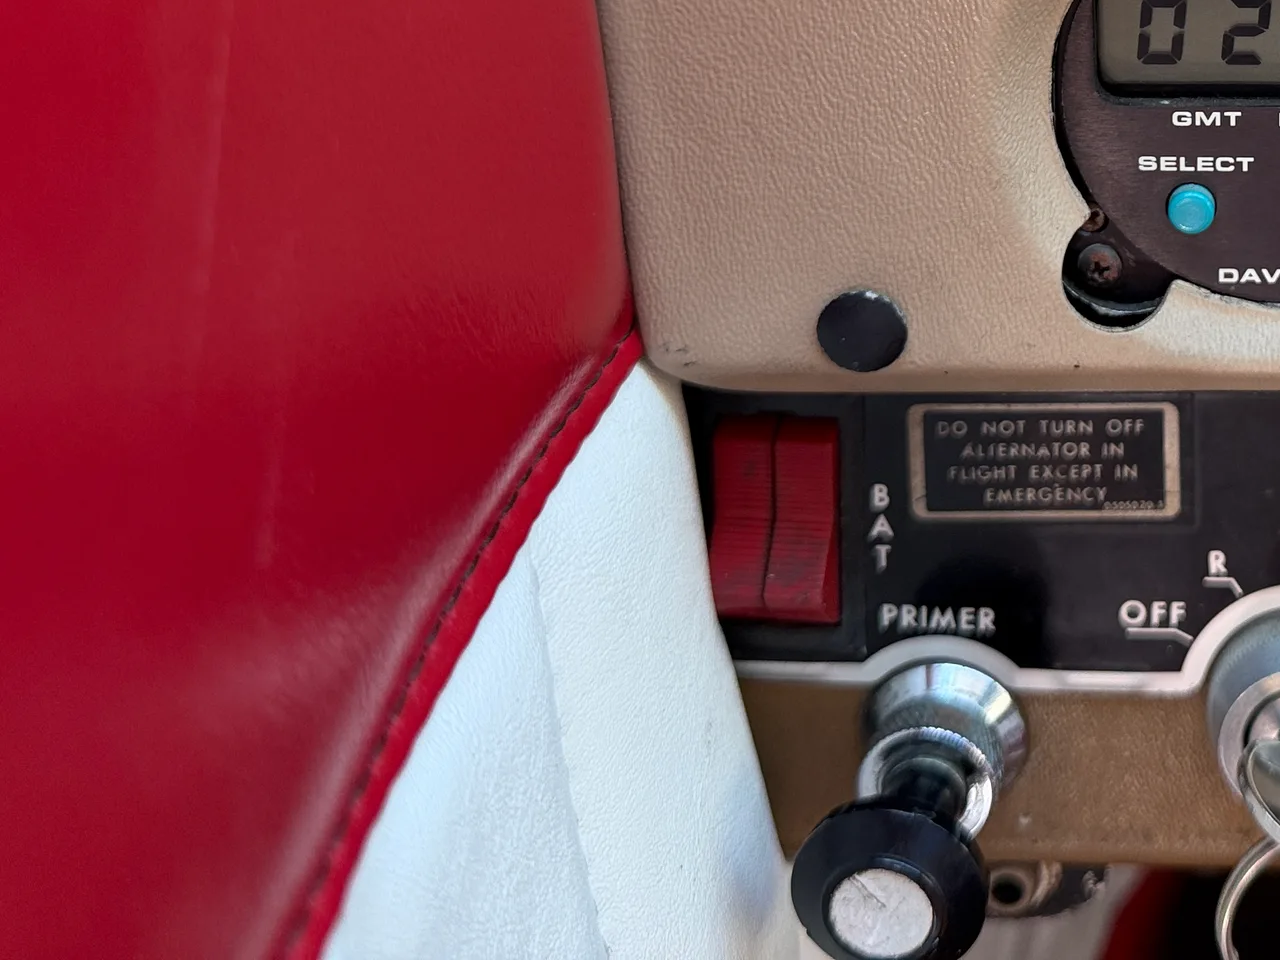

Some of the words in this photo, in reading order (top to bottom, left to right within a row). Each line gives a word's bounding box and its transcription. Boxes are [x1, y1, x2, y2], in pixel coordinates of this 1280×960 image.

[1171, 111, 1243, 128] GMT
[1138, 155, 1255, 173] SELECT
[937, 419, 968, 437] DO
[981, 419, 1026, 437] NOT
[1039, 419, 1094, 437] TURN
[1106, 418, 1146, 437] OFF
[961, 441, 1090, 459] ALTERNATOR
[1101, 442, 1125, 458] IN
[948, 464, 1018, 482] FLIGHT
[1029, 464, 1103, 482] EXCEPT
[1114, 464, 1139, 482] IN
[984, 486, 1108, 504] EMERGENCY
[869, 483, 894, 571] BAT
[1207, 550, 1228, 577] R
[879, 602, 996, 636] PRIMER
[1119, 599, 1188, 628] OFF
